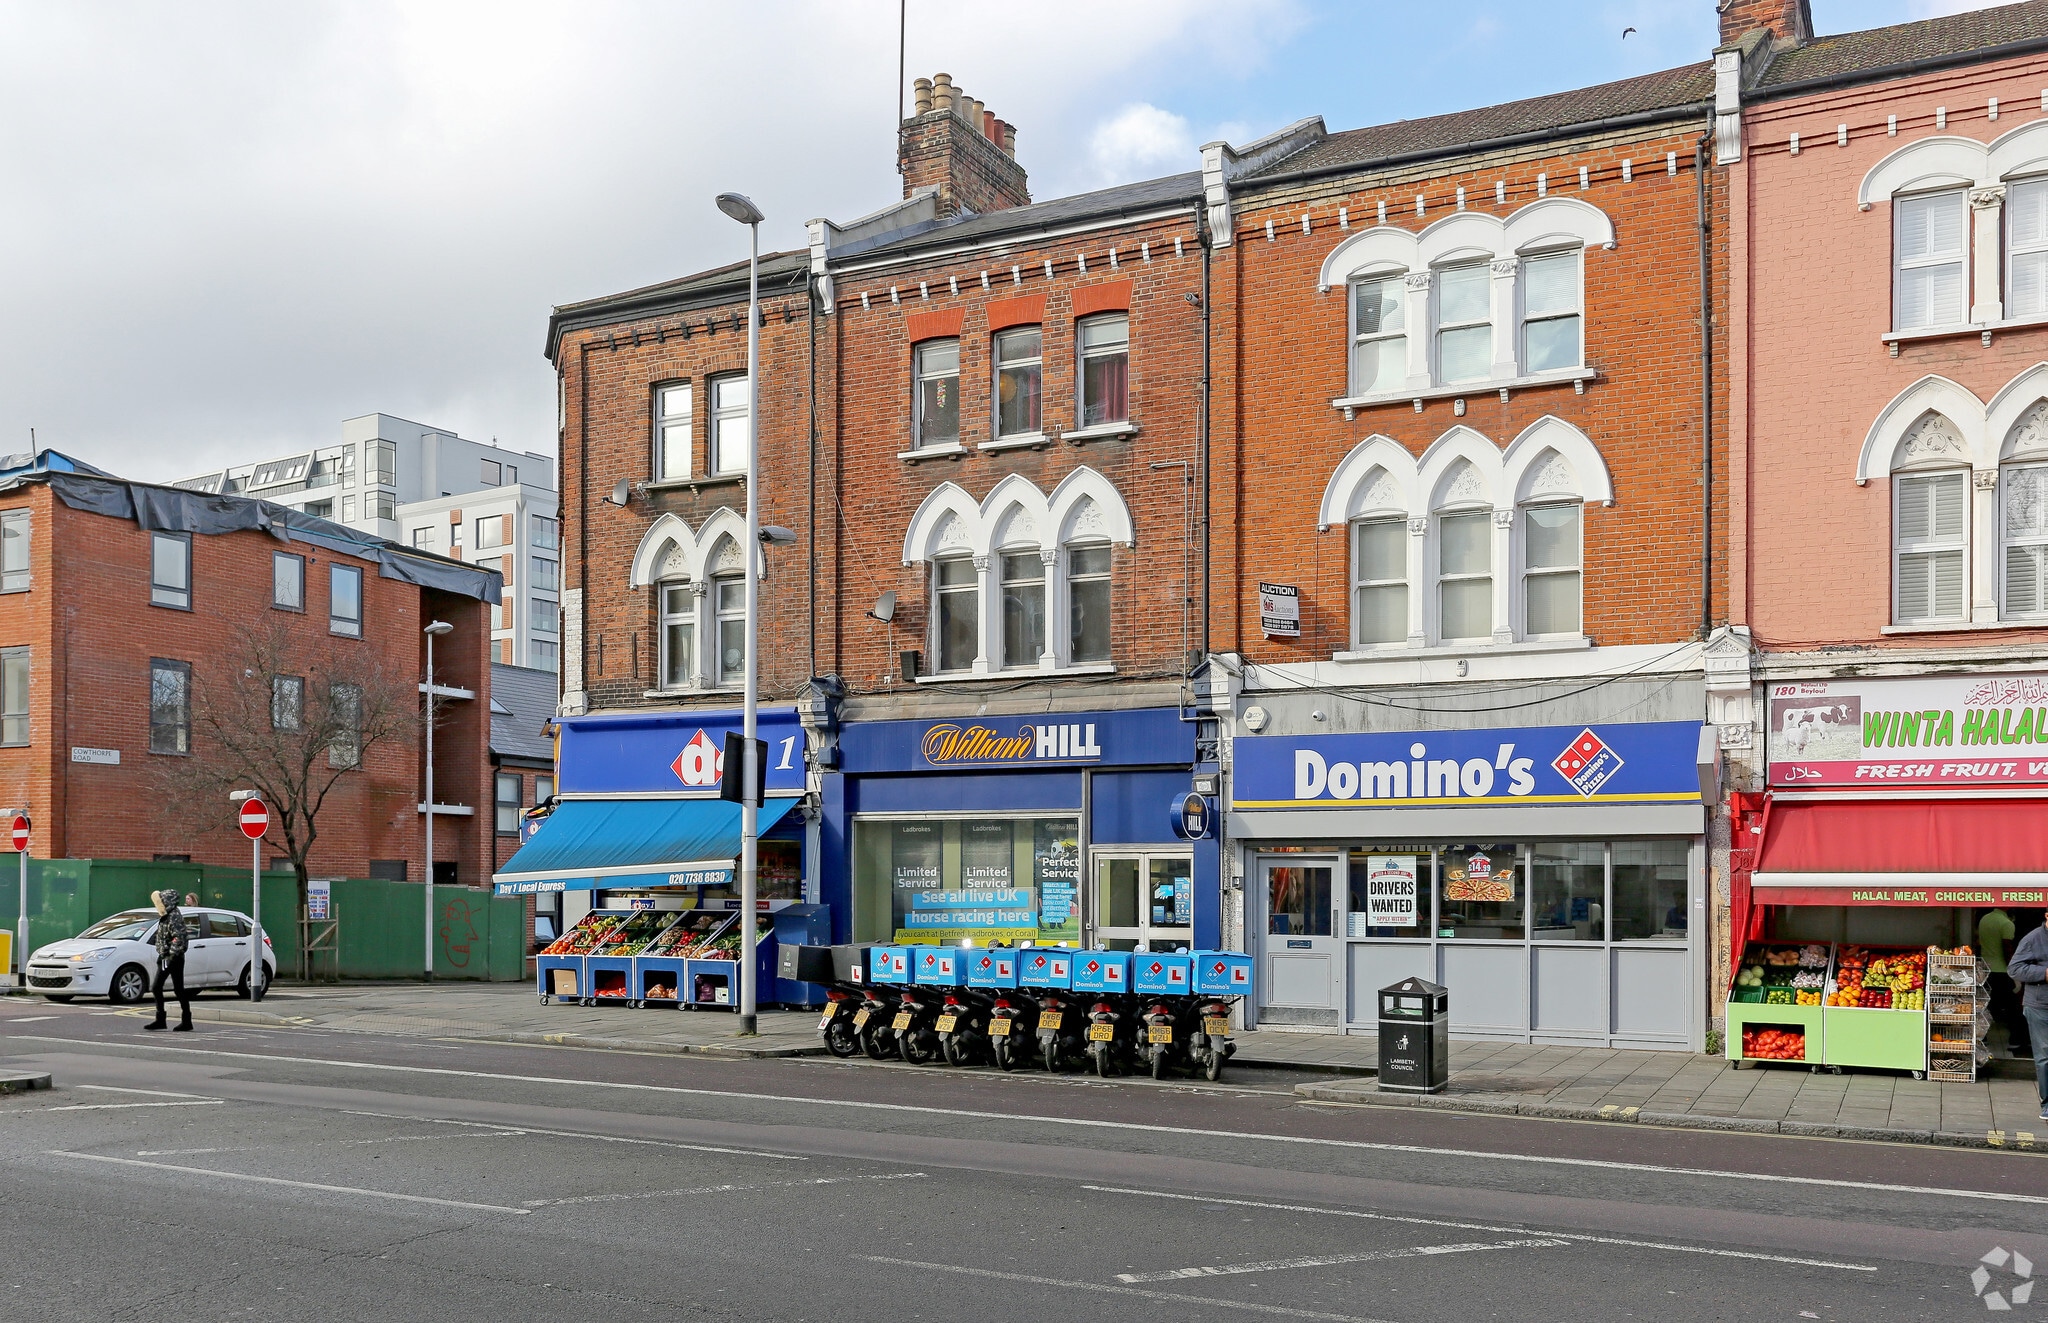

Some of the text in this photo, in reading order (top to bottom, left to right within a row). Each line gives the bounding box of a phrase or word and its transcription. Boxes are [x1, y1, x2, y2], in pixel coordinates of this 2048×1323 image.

[1261, 584, 1296, 596] AUCTION
[1775, 686, 1796, 696] 180
[1863, 707, 2048, 748] WINTA HALAL
[921, 723, 1101, 763] William HILL
[73, 748, 112, 757] COWTHORPE
[73, 754, 92, 762] ROAD
[774, 735, 796, 770] 1
[1294, 742, 1536, 800] Domino's
[1573, 752, 1610, 787] Domino's
[1785, 766, 1823, 781] حلال
[1855, 764, 1935, 779] FRESH
[1940, 762, 2018, 778] FRUIT,
[1581, 771, 1606, 794] Pizza
[1188, 815, 1203, 831] HILL
[1042, 856, 1079, 867] Perfect
[1468, 861, 1491, 872] £14.99
[897, 867, 937, 877] Limited
[966, 866, 1008, 877] Limited
[1042, 868, 1079, 878] Service
[669, 871, 726, 884] 020 7738 8830
[898, 878, 937, 888] Service
[967, 878, 1008, 888] Service
[499, 881, 566, 894] Day 1 Local Express
[1370, 881, 1414, 895] DRIVERS
[921, 887, 1018, 904] See all live UK
[1852, 891, 2043, 903] HALAL MEAT, CHICKEN, FRESH
[1371, 899, 1413, 912] WANTED
[911, 908, 1030, 925] horse racing here
[897, 930, 913, 938] (you
[916, 930, 930, 938] can't
[931, 930, 939, 938] at
[1015, 929, 1036, 938] Coral)
[895, 960, 903, 970] L
[942, 961, 950, 972] L
[1000, 963, 1009, 975] L
[1055, 963, 1064, 974] L
[853, 968, 860, 979] L
[1109, 968, 1118, 979] L
[1172, 969, 1182, 981] L
[1235, 969, 1245, 981] L
[1040, 1012, 1061, 1020] KW66
[990, 1019, 1010, 1027] KM66
[1206, 1018, 1228, 1026] KW66
[1091, 1024, 1113, 1032] KP66
[1149, 1026, 1171, 1034] KM66
